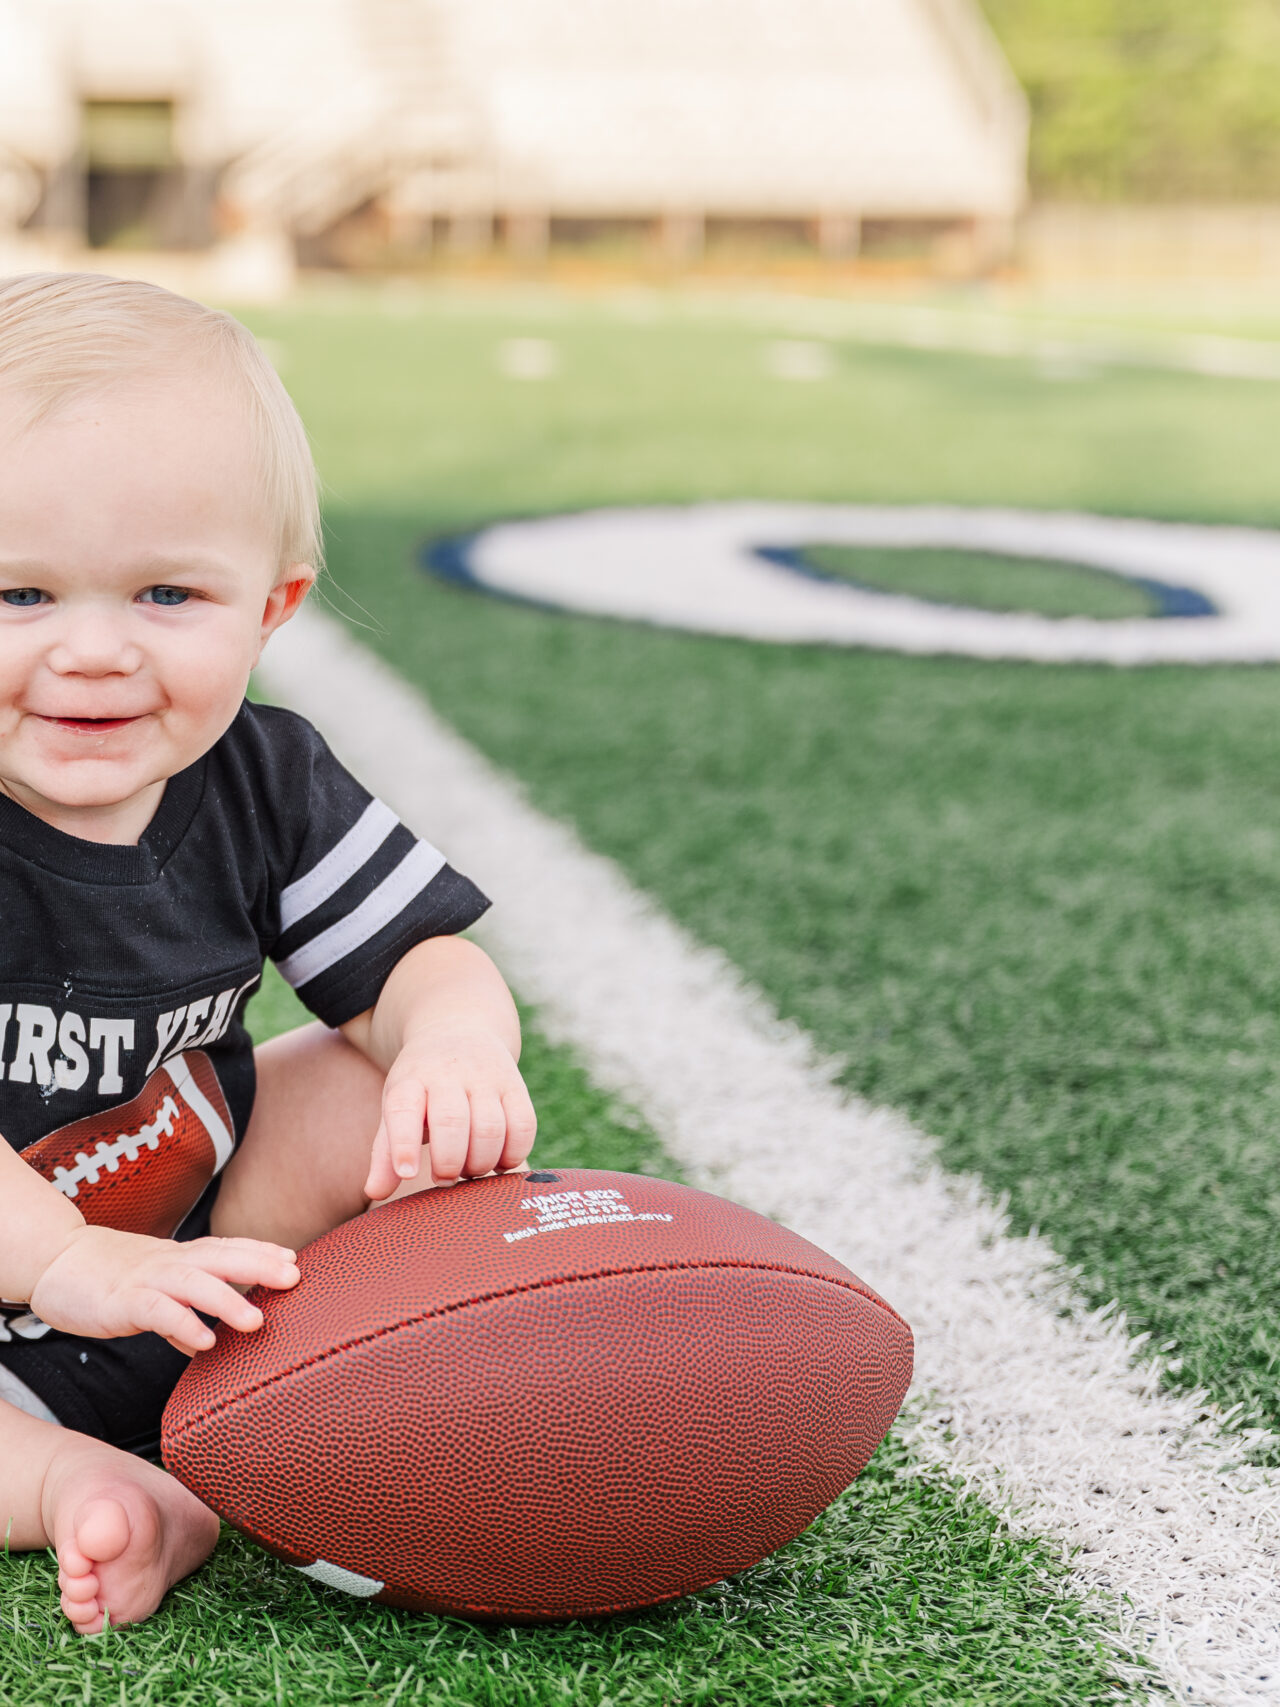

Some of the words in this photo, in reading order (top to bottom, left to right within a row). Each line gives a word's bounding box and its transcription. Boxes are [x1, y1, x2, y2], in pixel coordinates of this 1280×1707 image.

[521, 1191, 584, 1210] JUNIOR
[583, 1188, 625, 1200] SIZE
[569, 1200, 584, 1209] in
[582, 1199, 617, 1207] China
[503, 1226, 539, 1243] Batch
